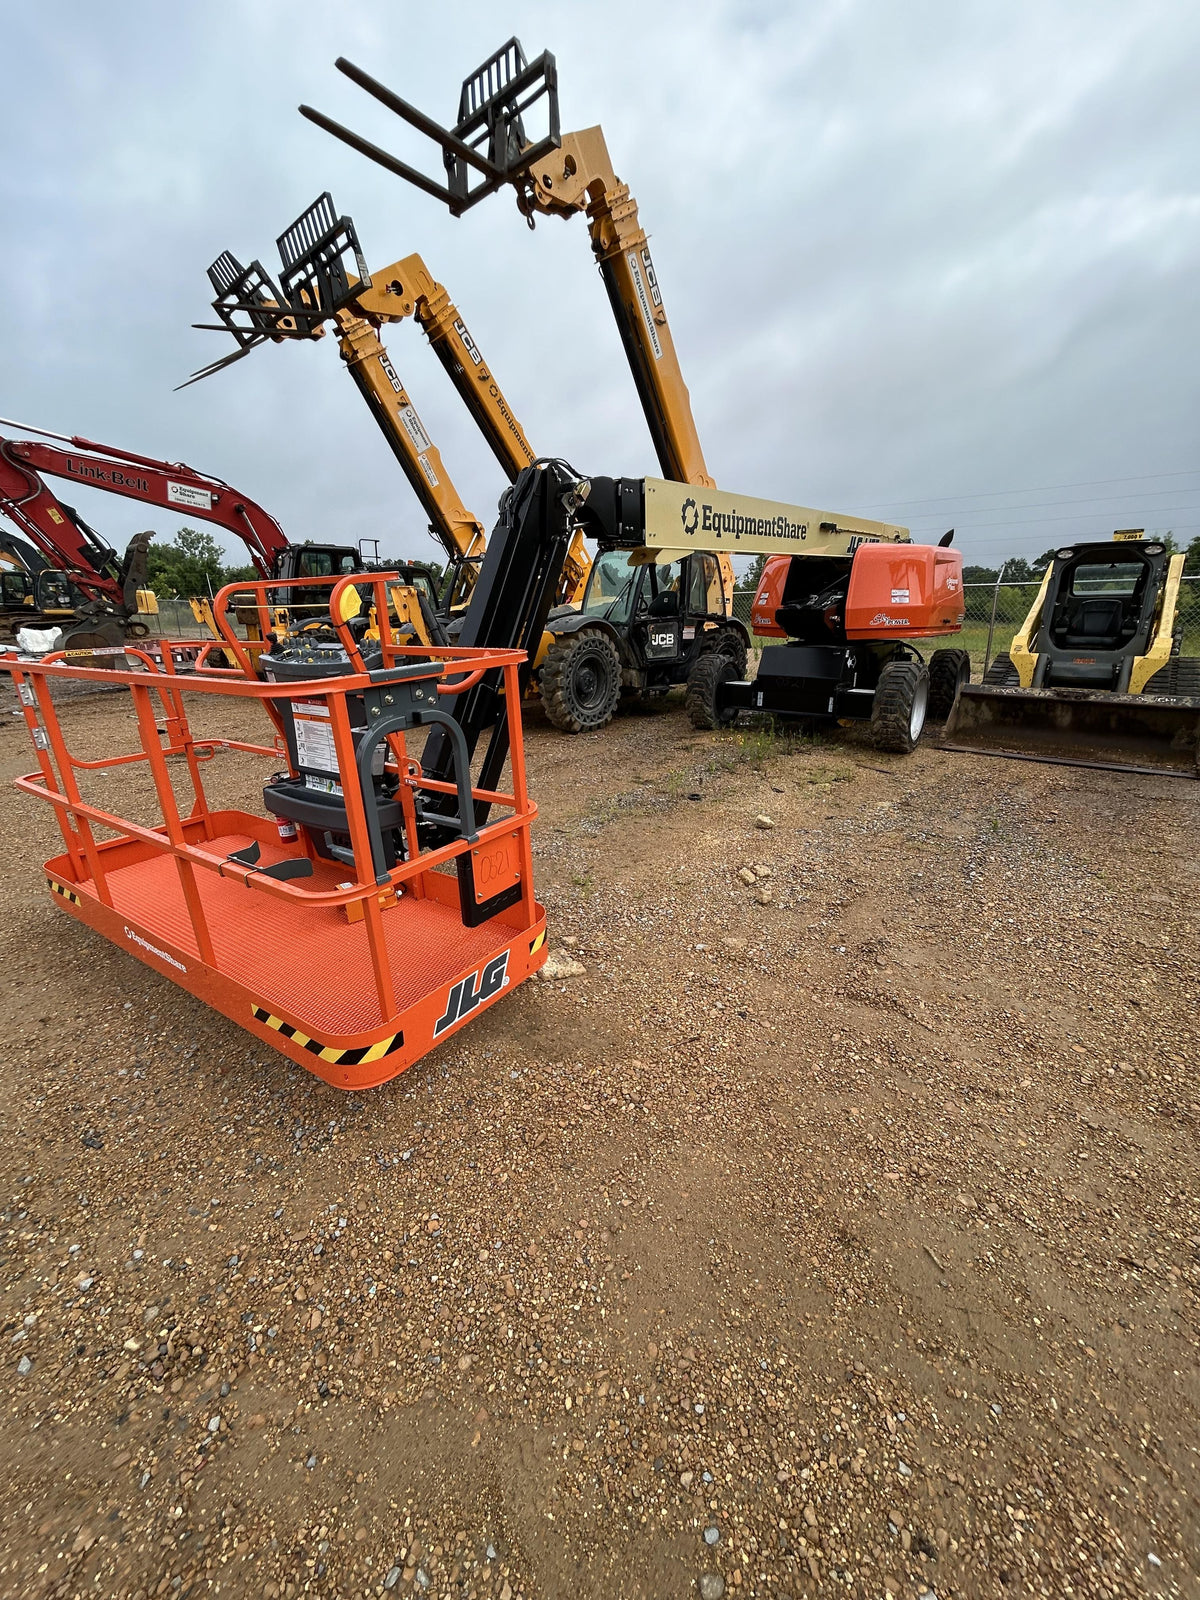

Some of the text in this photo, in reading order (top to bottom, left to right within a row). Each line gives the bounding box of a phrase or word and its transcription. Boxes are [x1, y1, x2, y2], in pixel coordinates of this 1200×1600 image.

[641, 247, 662, 307] JCB
[633, 269, 660, 355] EquipmentShare
[453, 318, 482, 366] JCB
[378, 353, 404, 394] JCB
[496, 398, 535, 464] EquipmentS
[67, 459, 149, 492] Link-Belt
[179, 486, 209, 498] Equipment
[179, 491, 196, 499] Share
[702, 504, 807, 541] EquipmentShare
[651, 633, 674, 646] JCB
[433, 949, 510, 1040] JLG
